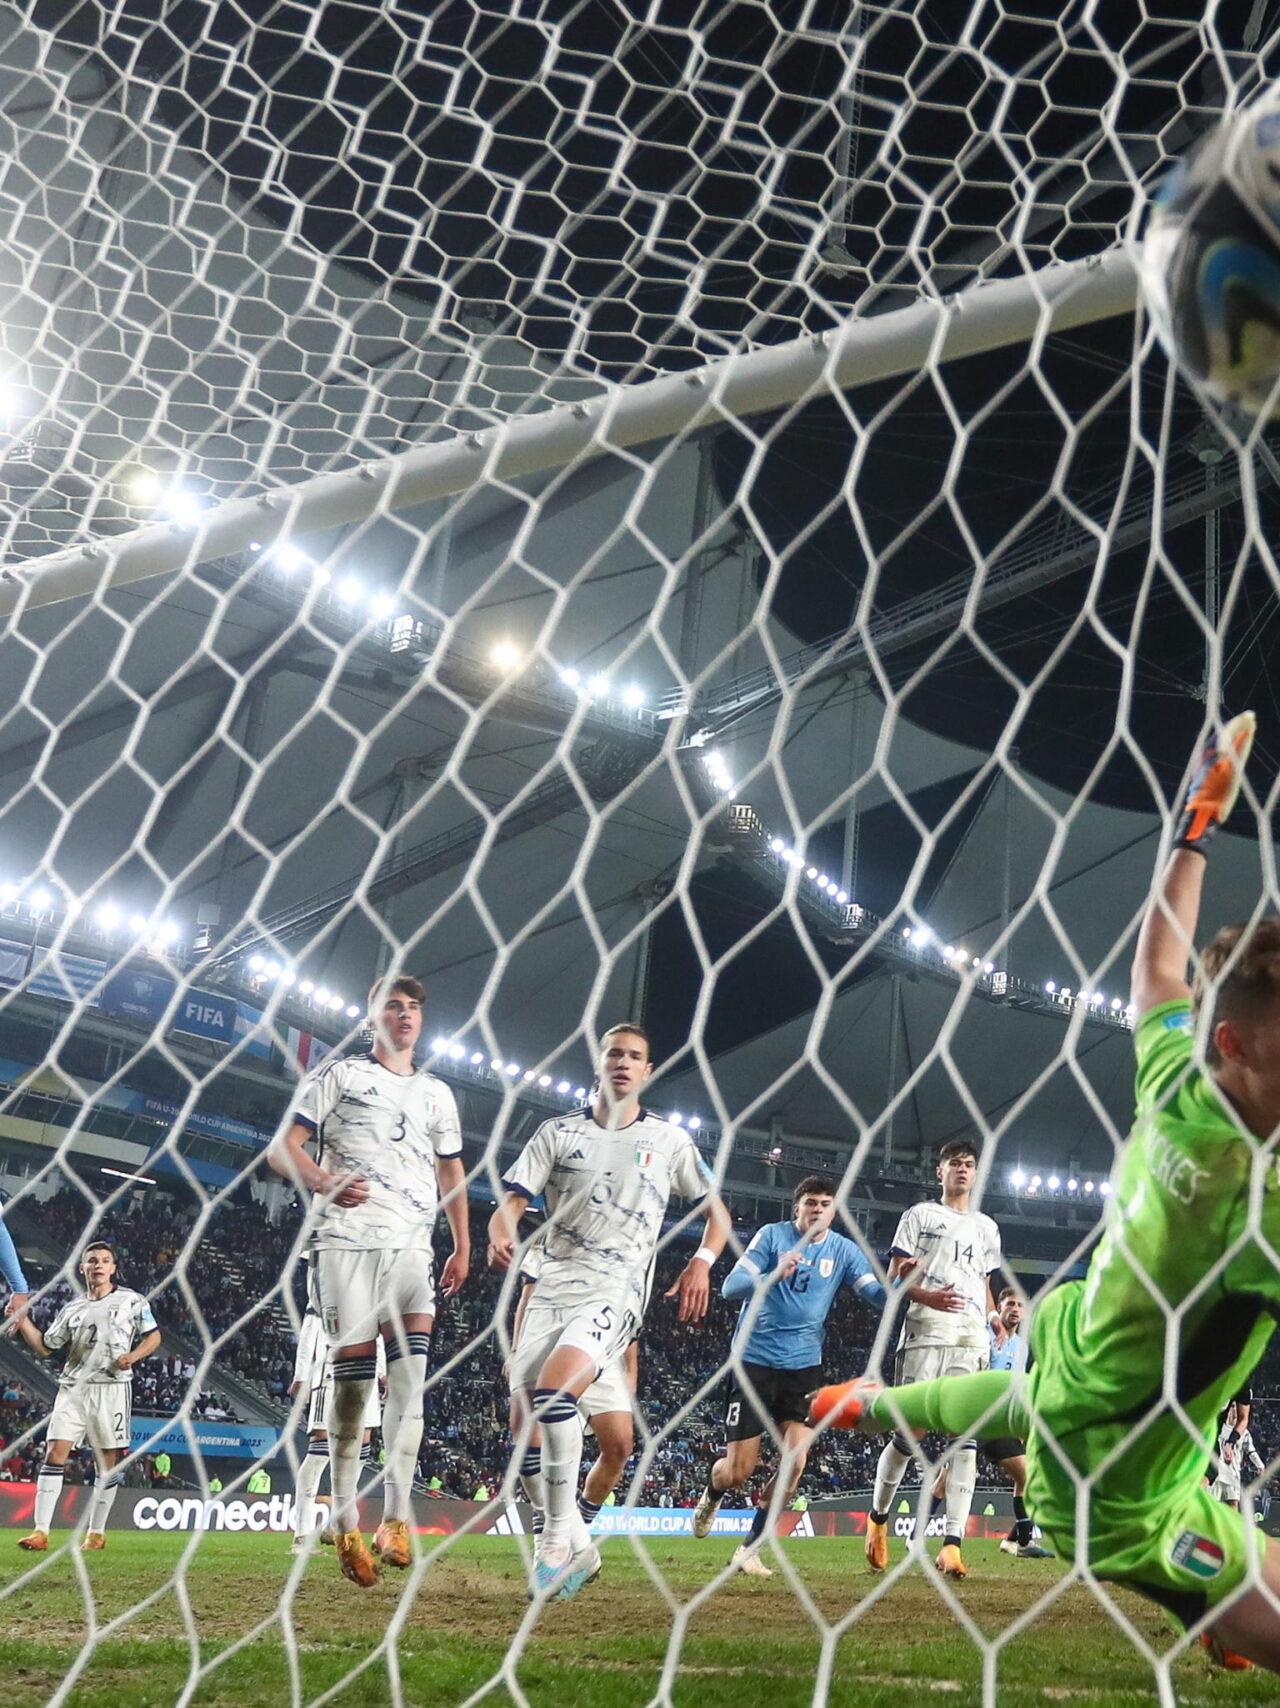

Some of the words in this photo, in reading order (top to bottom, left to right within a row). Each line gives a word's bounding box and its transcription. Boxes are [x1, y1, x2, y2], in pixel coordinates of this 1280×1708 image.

[185, 1002, 224, 1028] FIFA
[145, 1099, 162, 1112] FIFA
[390, 1110, 406, 1142] 3
[954, 1240, 974, 1264] 14
[790, 1268, 811, 1293] 13
[592, 1304, 619, 1330] 5
[88, 1323, 98, 1345] 2
[114, 1412, 124, 1432] 2
[725, 1402, 741, 1427] 13
[142, 1432, 176, 1443] WRLD
[196, 1436, 241, 1447] ARGENTINA
[615, 1516, 659, 1532] WORLD
[661, 1517, 684, 1532] CUP
[684, 1518, 741, 1533] ANTINA
